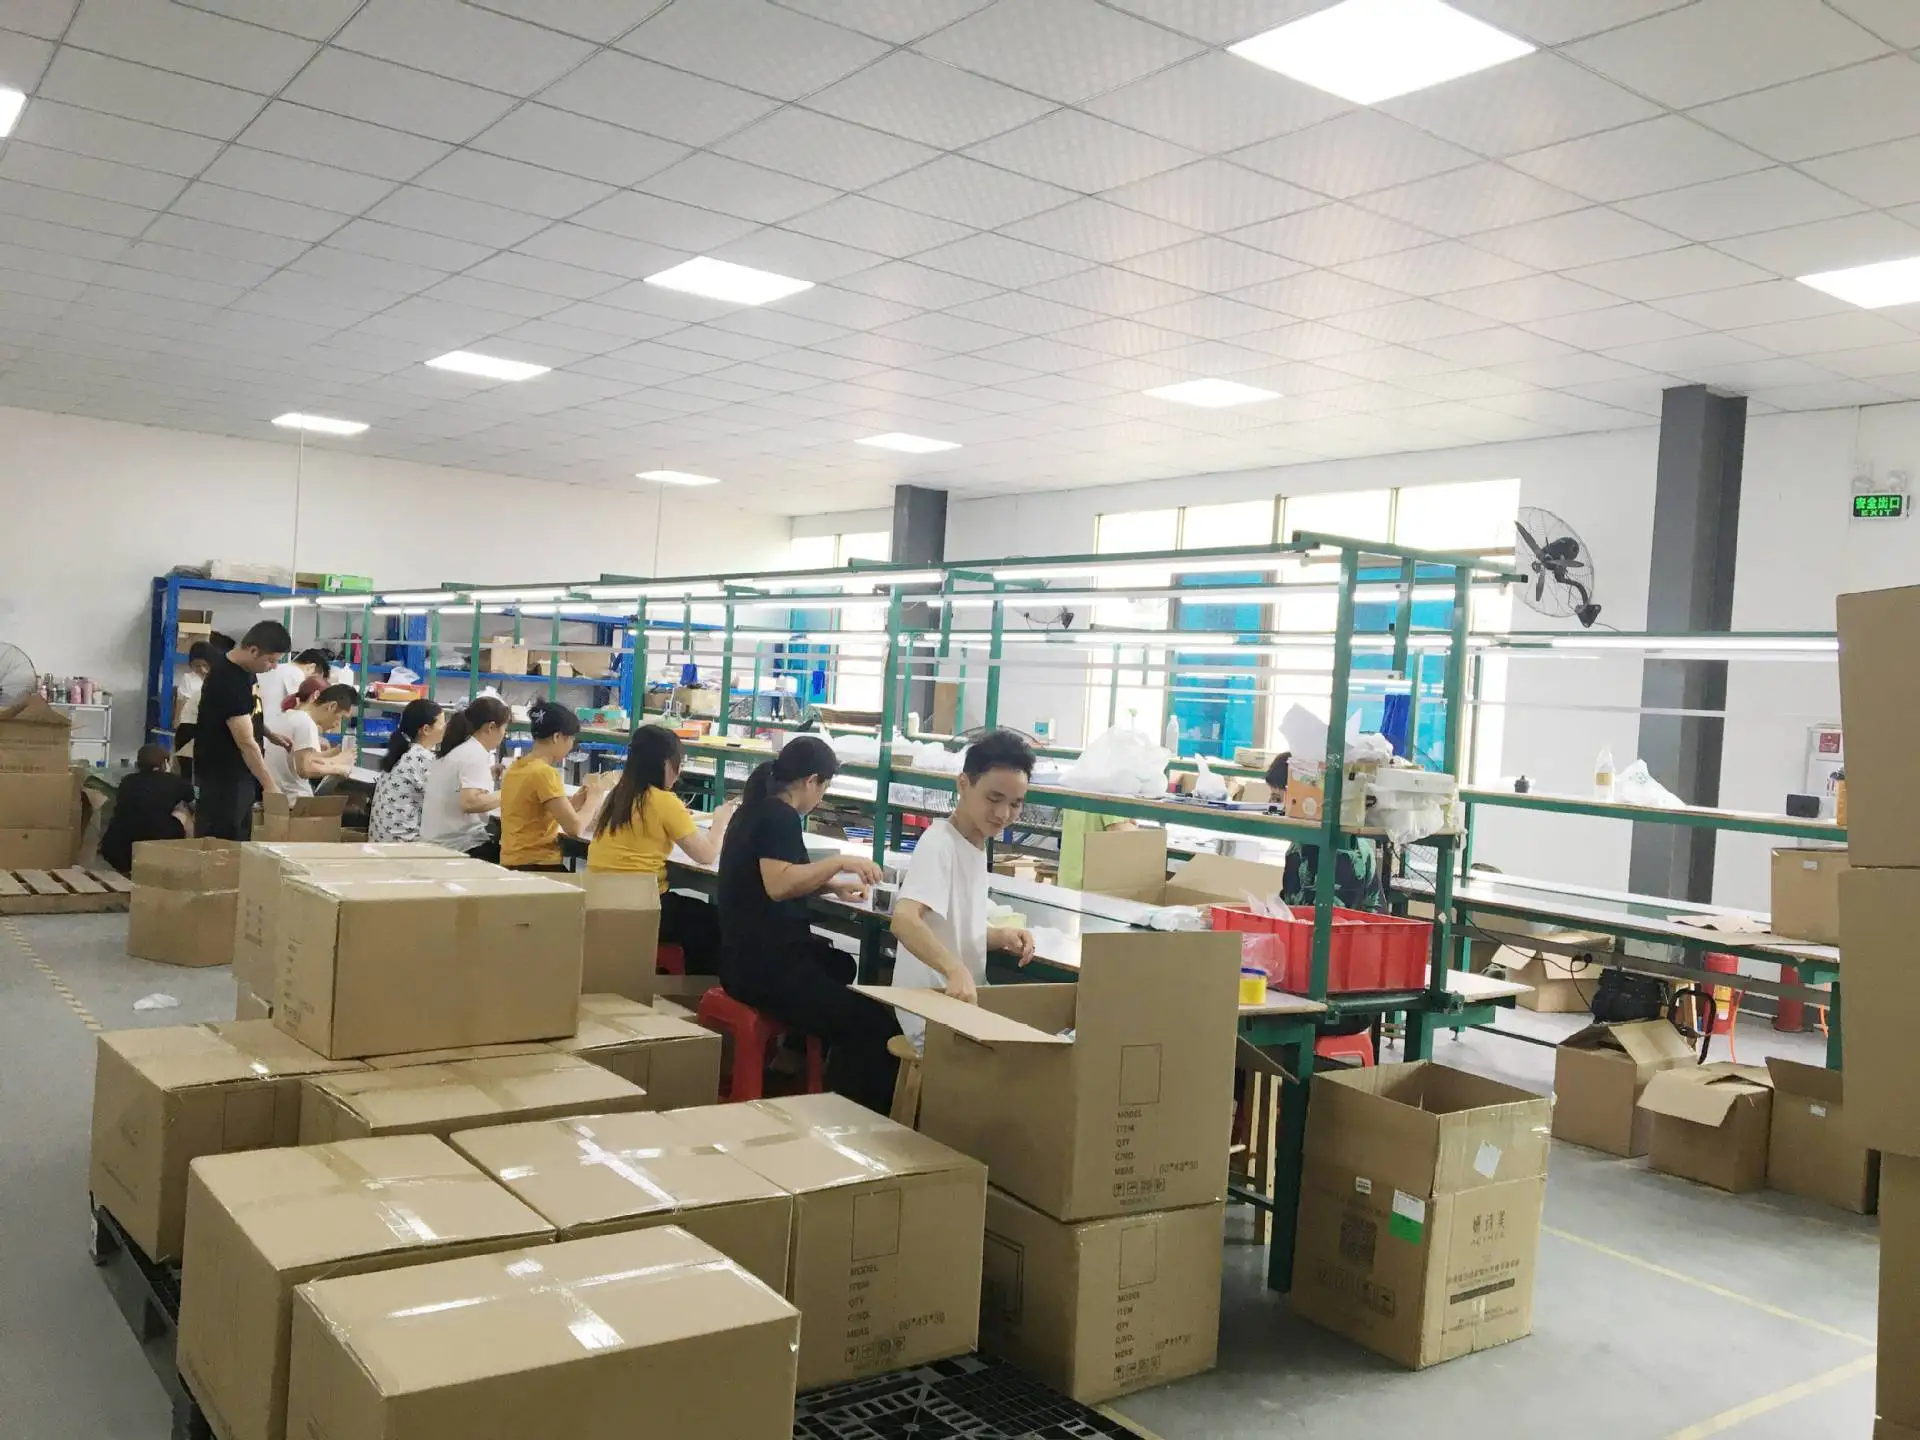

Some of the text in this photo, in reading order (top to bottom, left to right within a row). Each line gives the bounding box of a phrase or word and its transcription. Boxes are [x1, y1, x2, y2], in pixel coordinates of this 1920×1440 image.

[1855, 496, 1900, 509] 安全出口
[1861, 509, 1893, 517] EXIT
[1116, 1124, 1135, 1133] ITEM
[1115, 1138, 1130, 1148] QTY
